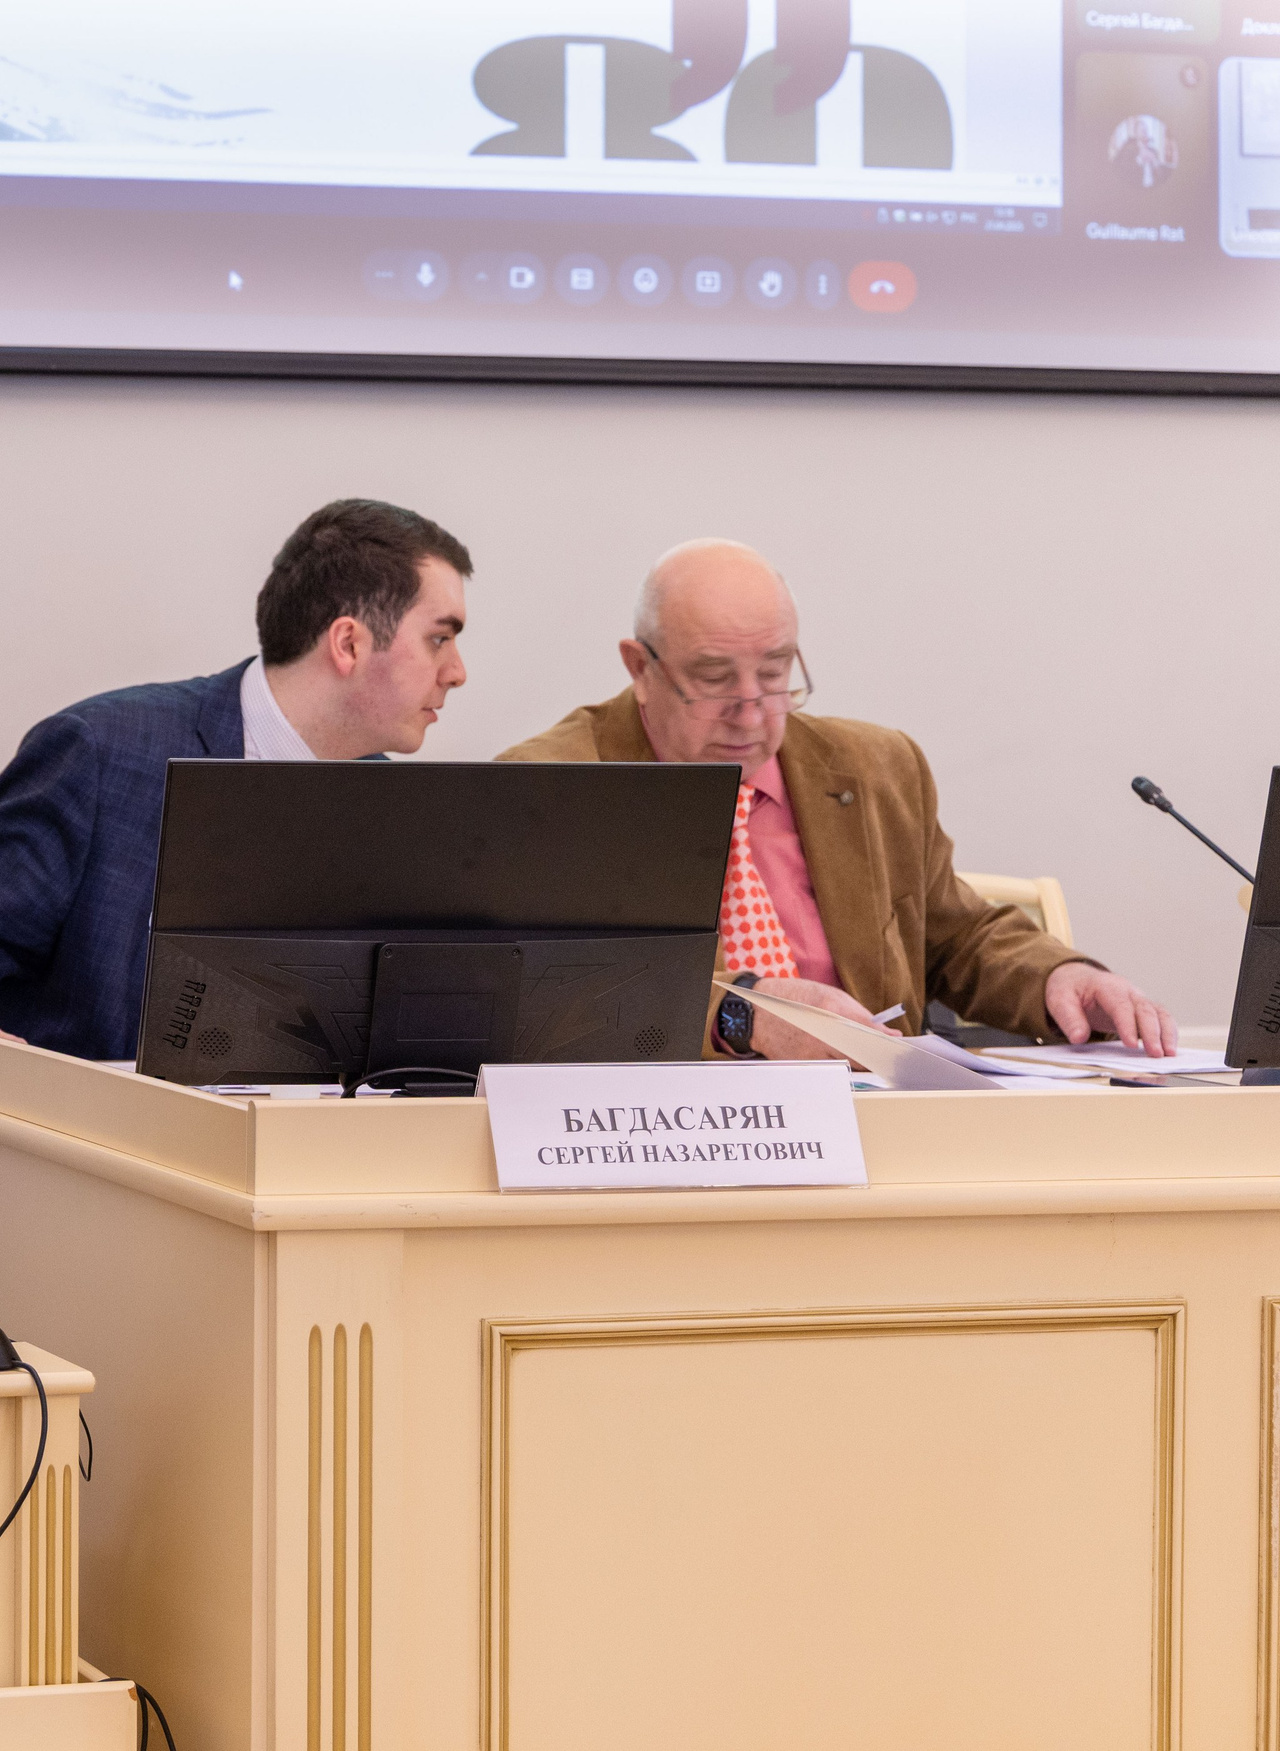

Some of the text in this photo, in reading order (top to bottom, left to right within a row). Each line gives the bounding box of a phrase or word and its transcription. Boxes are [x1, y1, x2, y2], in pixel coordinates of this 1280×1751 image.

[1085, 10, 1139, 30] Сергей
[1086, 221, 1158, 241] Guillaume
[561, 1104, 788, 1137] БАГДАСАРЯН
[537, 1141, 825, 1165] СЕРГЕЙ НАЗАРЕТОВИЧ
